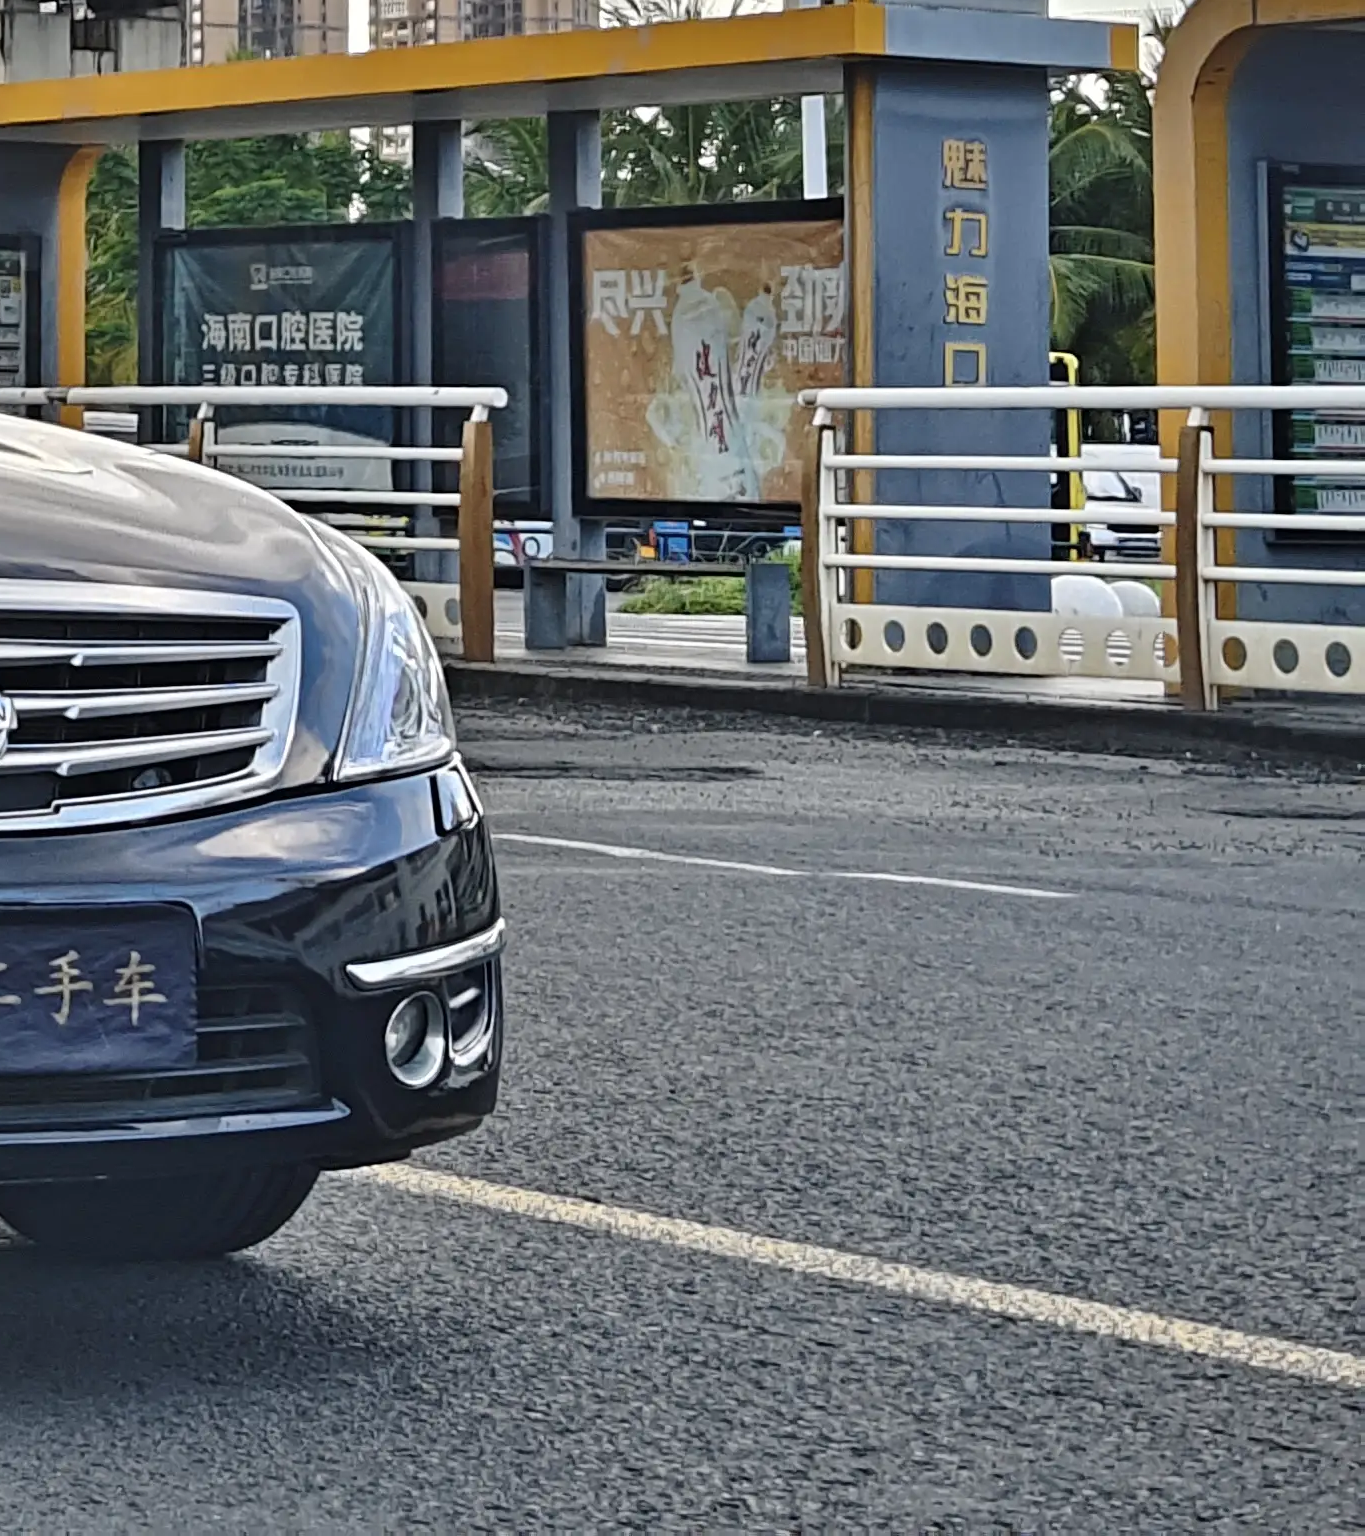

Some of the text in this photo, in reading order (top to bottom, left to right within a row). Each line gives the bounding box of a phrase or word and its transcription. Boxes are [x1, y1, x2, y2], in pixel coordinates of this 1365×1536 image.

[943, 138, 988, 387] 魅力海口
[201, 311, 364, 352] 海南口腔医院
[590, 269, 669, 338] 尽兴
